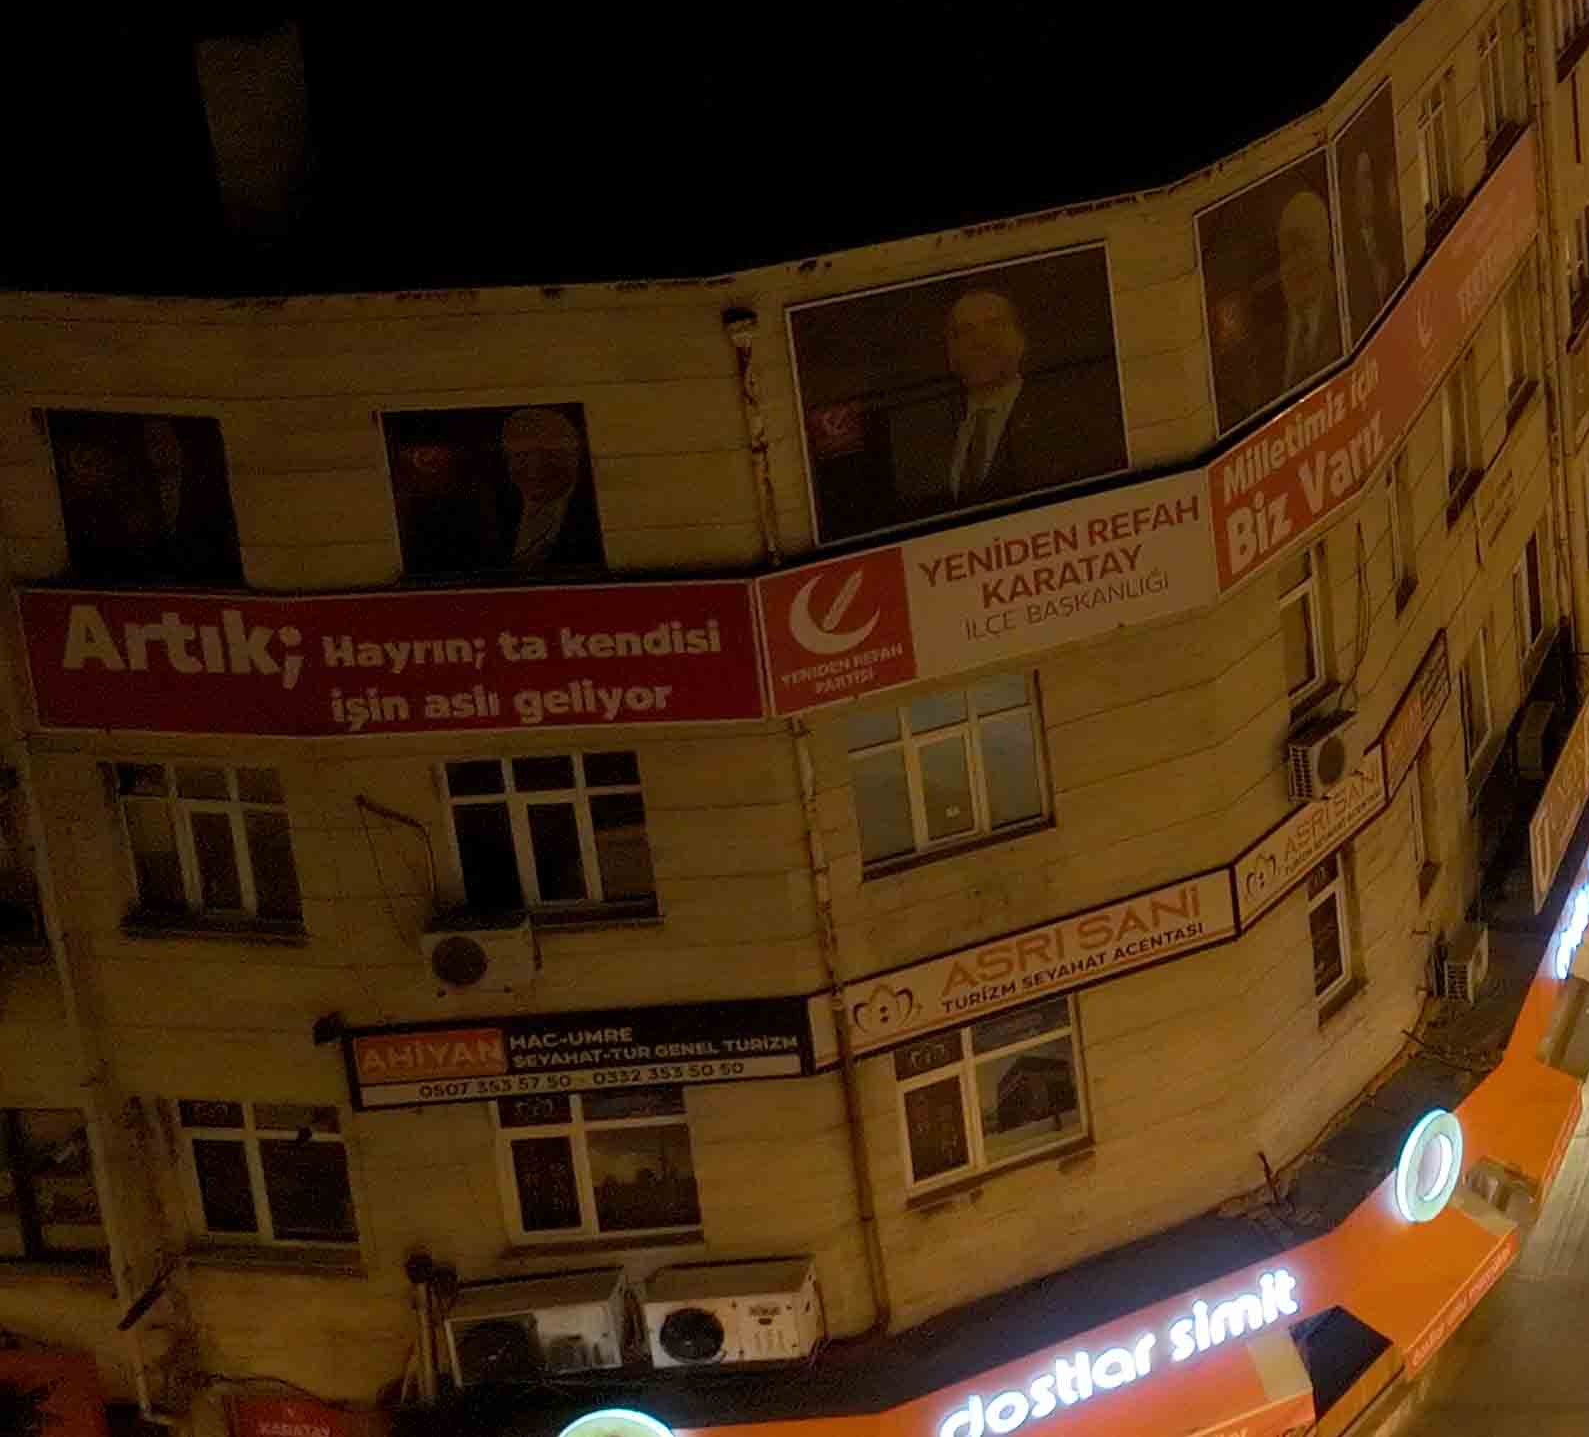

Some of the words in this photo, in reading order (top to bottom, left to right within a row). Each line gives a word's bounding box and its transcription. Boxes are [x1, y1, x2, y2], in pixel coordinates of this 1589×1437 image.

[1222, 385, 1348, 507] Milletimiz
[1226, 489, 1295, 576] Biz
[1297, 411, 1386, 516] Varız
[918, 523, 1079, 589] YENİDEN
[1087, 495, 1201, 547] REFAH
[981, 543, 1144, 609] KARATAY
[1025, 566, 1170, 626] BAŞKANLIĞI
[61, 604, 303, 690] Artık;
[321, 634, 486, 676] Hayrın;
[502, 630, 546, 663] ta
[558, 619, 723, 661] kendisi
[781, 657, 850, 686] YENİDEN
[852, 641, 905, 665] REFAH
[327, 687, 411, 731] işin
[514, 679, 674, 725] geliyor
[940, 980, 1018, 1014] TURİZM
[1020, 952, 1107, 990] SEYAHAT
[1112, 921, 1204, 961] ACENTASI
[941, 926, 1065, 997] ASRI
[509, 1026, 634, 1051] HAC-UMRE
[511, 1043, 652, 1069] SEYAHAT-TUR
[655, 1037, 719, 1060] GENEL
[721, 1033, 799, 1054] TURİZM
[939, 1331, 1156, 1437] dostlar
[1169, 1267, 1299, 1362] simit
